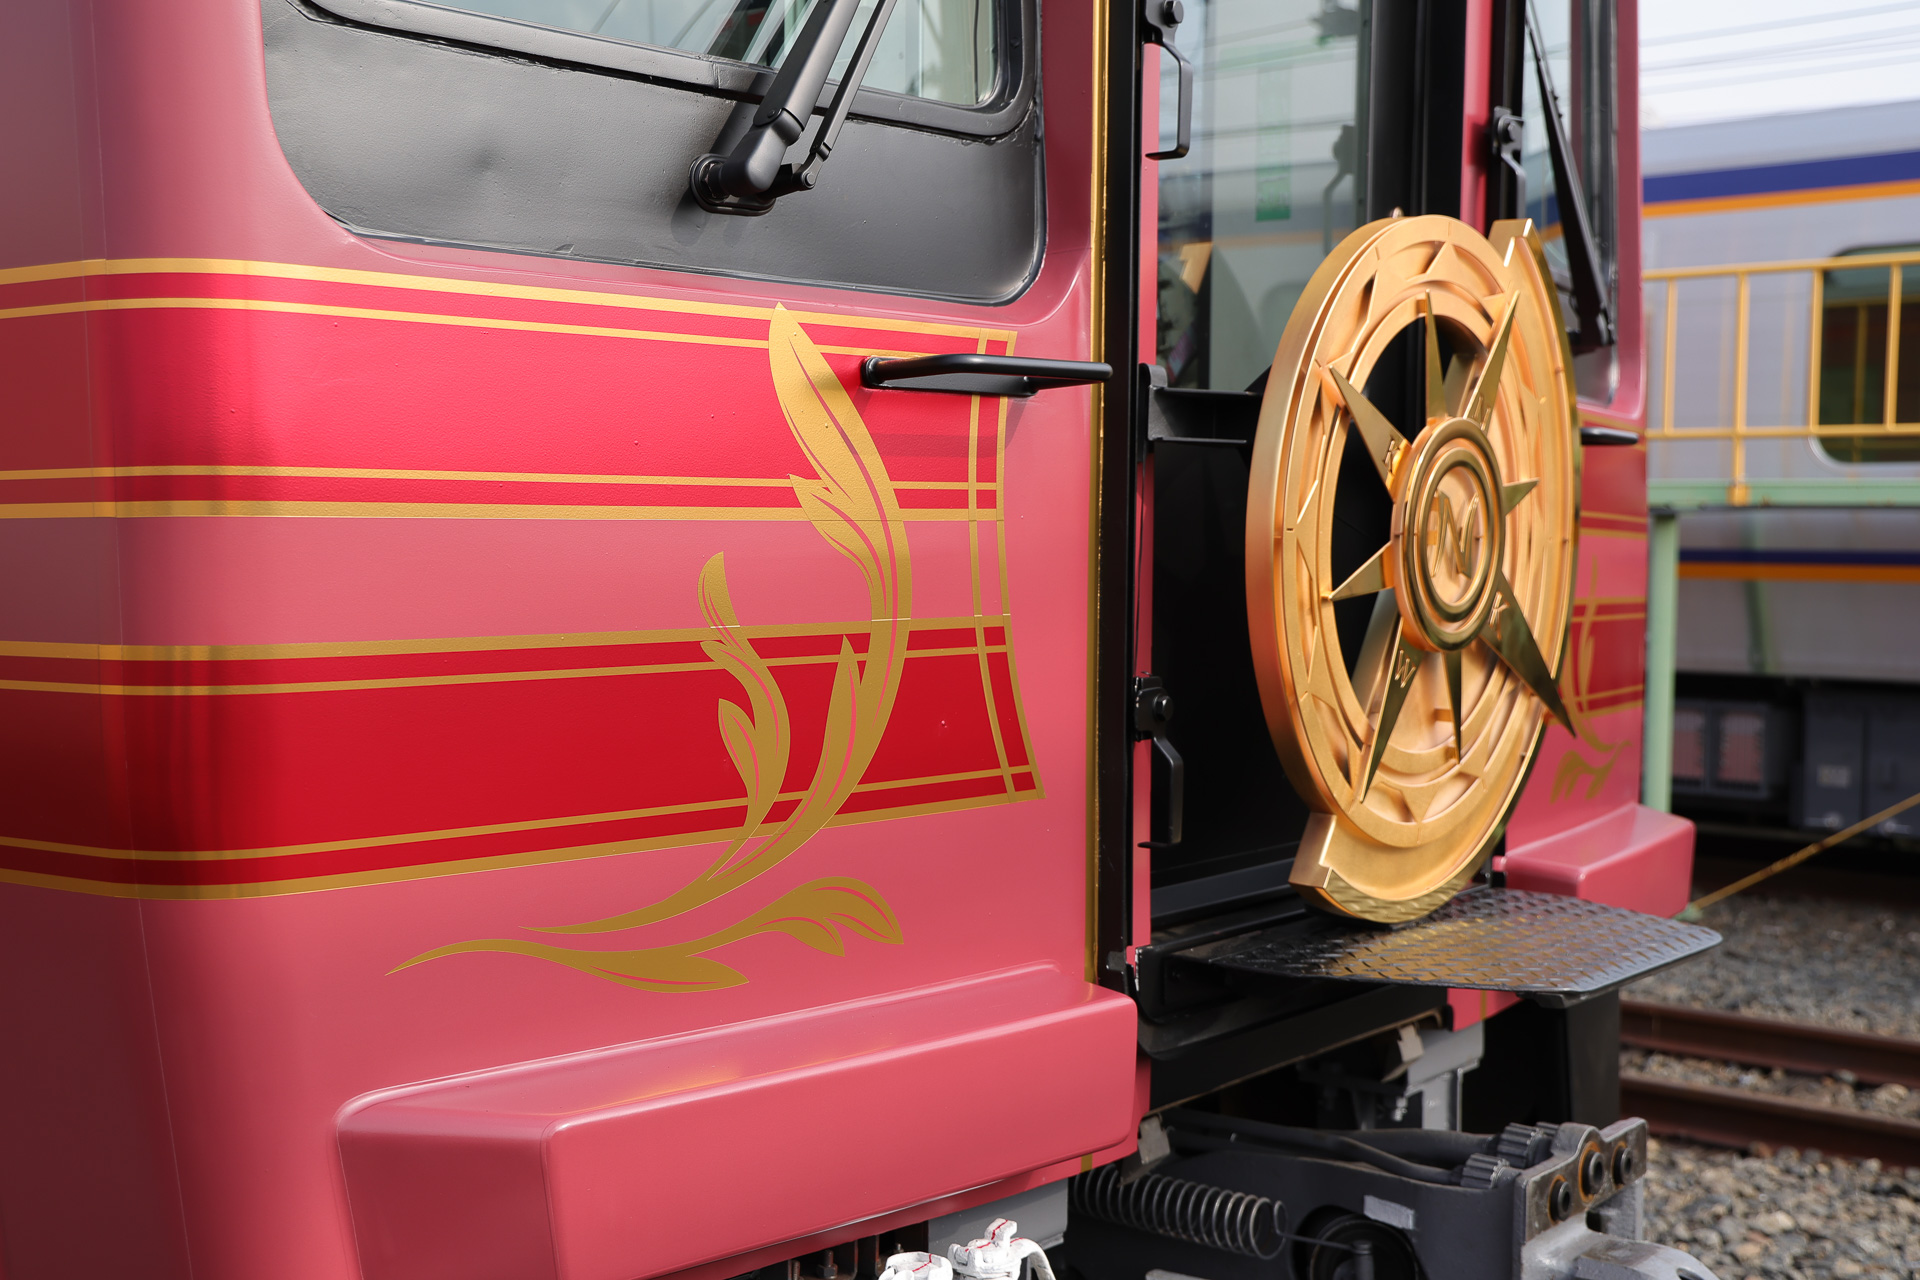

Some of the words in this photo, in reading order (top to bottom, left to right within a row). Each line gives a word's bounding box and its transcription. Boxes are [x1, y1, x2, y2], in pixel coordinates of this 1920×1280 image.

[1430, 490, 1479, 579] N
[1488, 591, 1510, 640] K
[1395, 648, 1416, 688] W
